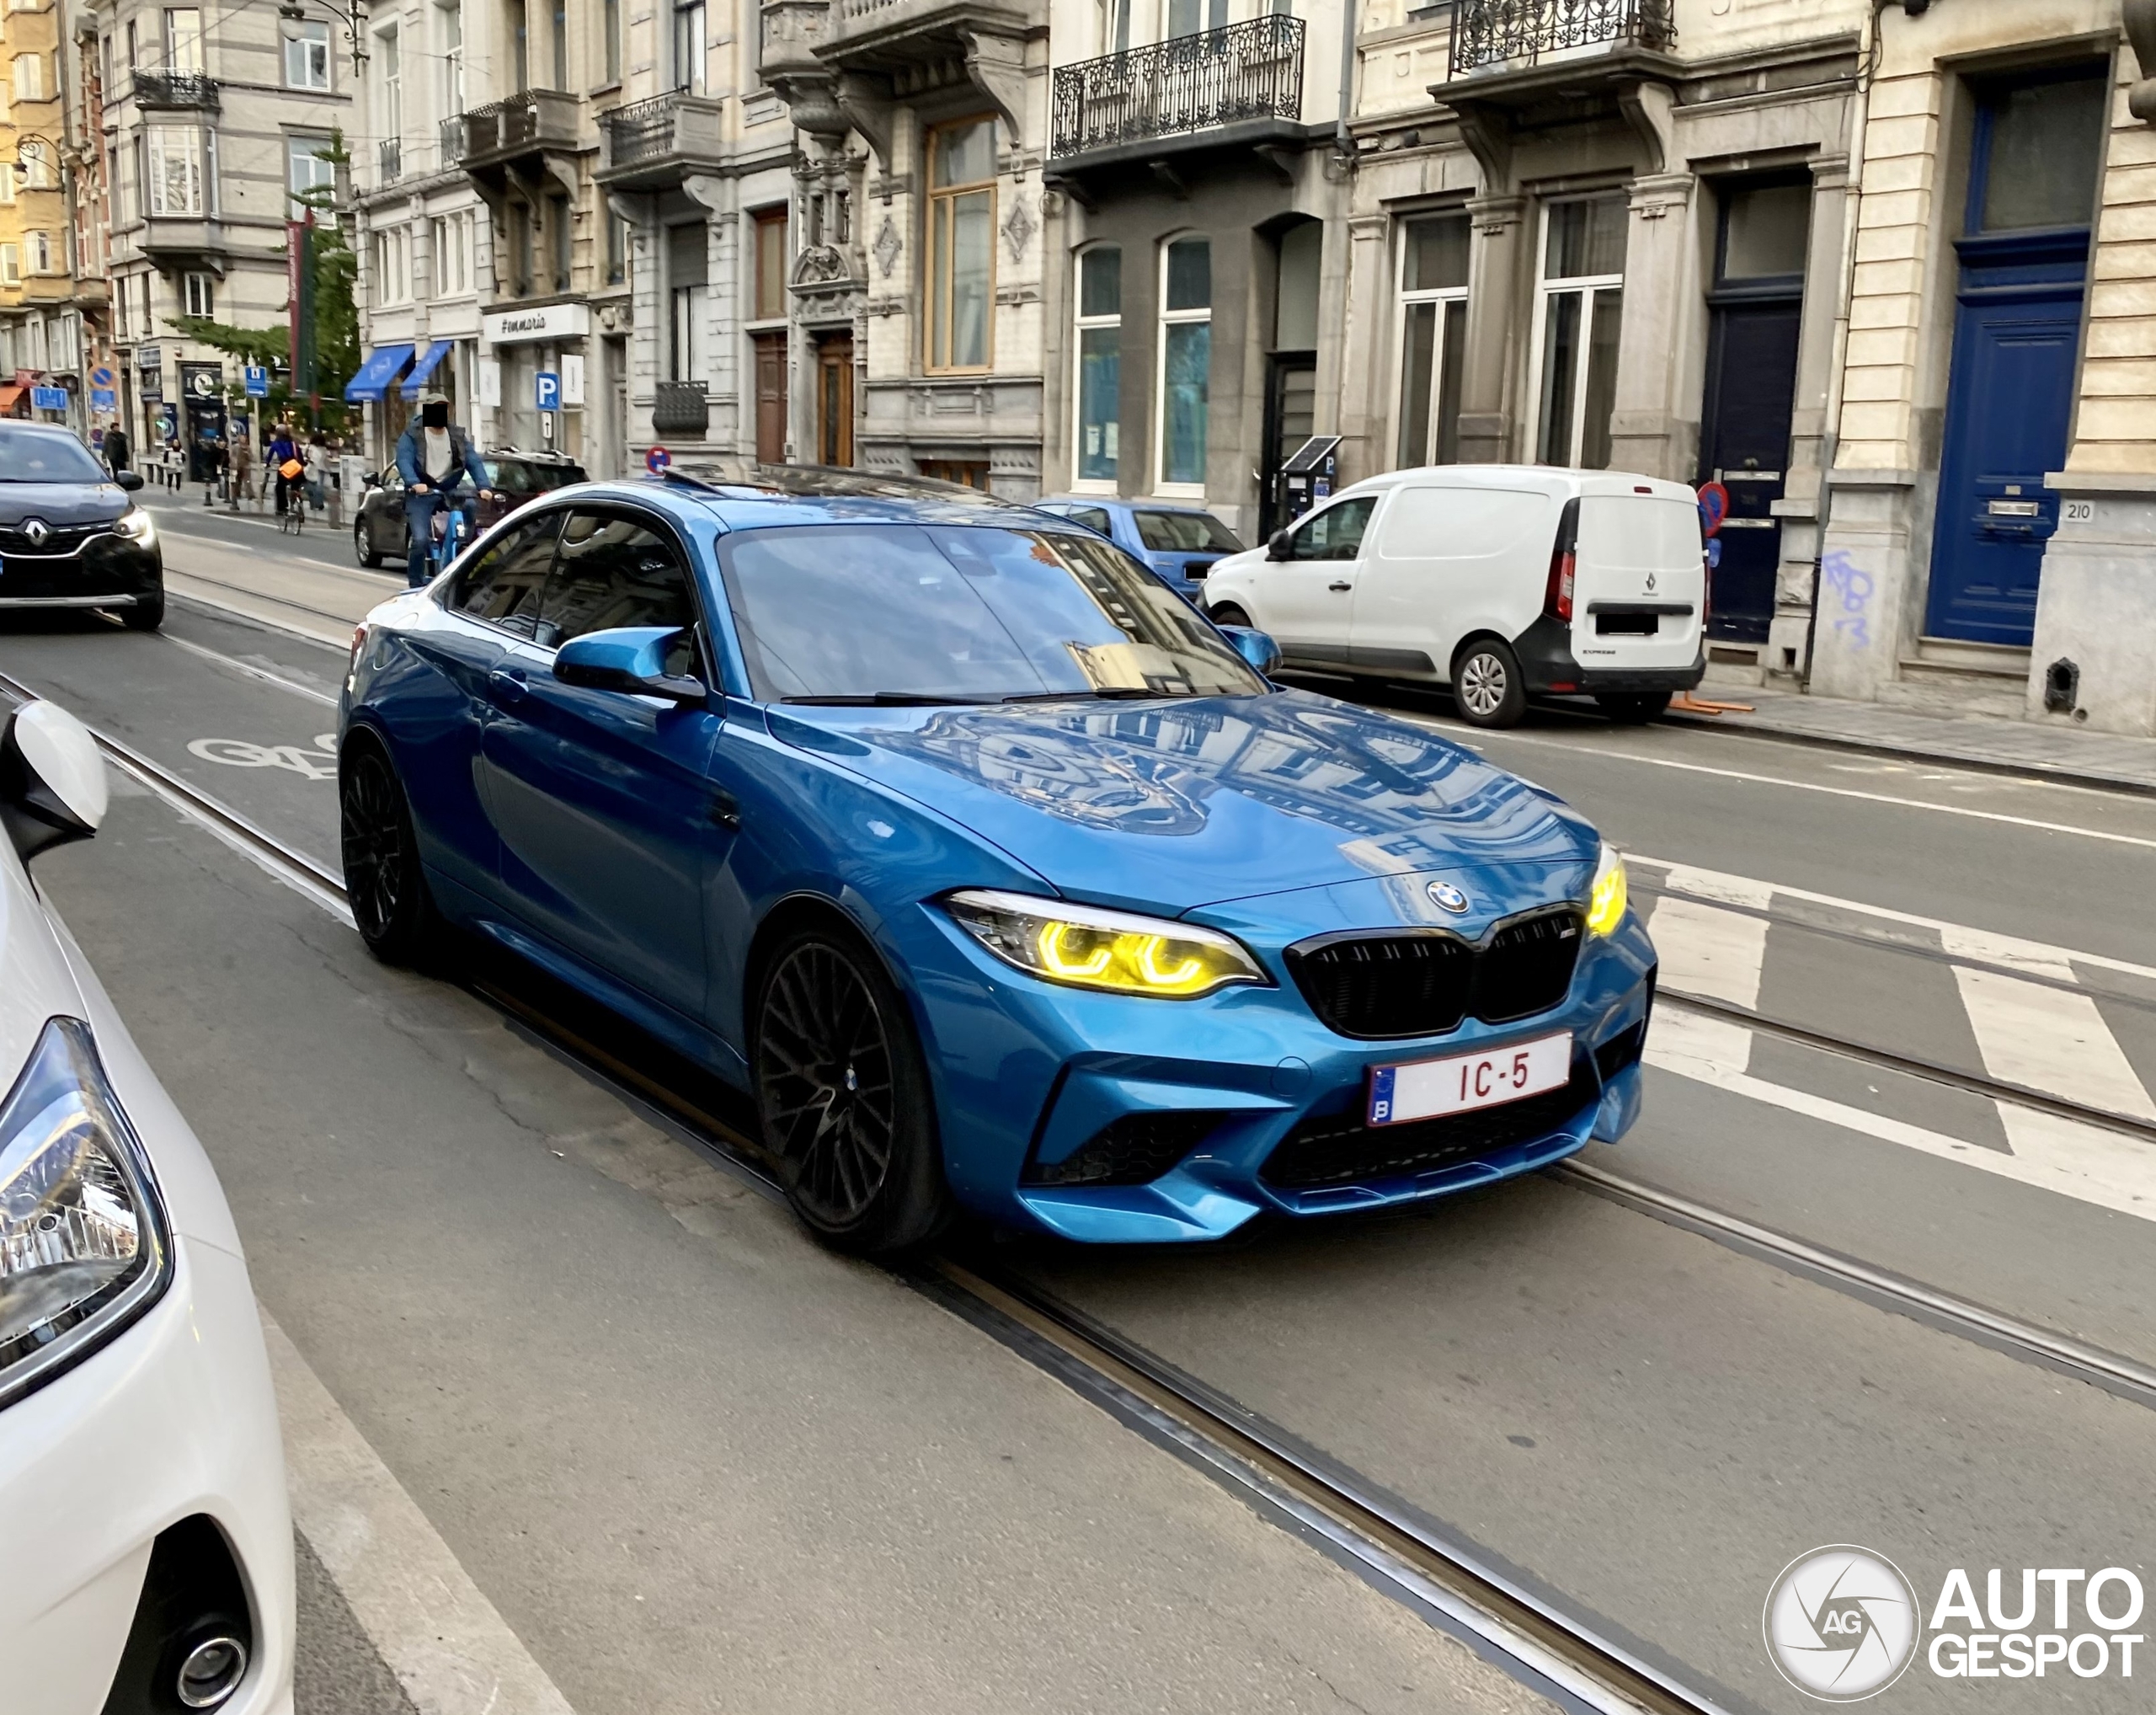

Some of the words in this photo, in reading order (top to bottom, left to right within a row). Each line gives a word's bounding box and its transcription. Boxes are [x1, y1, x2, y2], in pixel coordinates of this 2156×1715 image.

[539, 377, 556, 405] P
[1326, 456, 1334, 471] P
[2068, 505, 2090, 519] 210
[1460, 1052, 1529, 1101] IC-5
[1374, 1100, 1389, 1119] B
